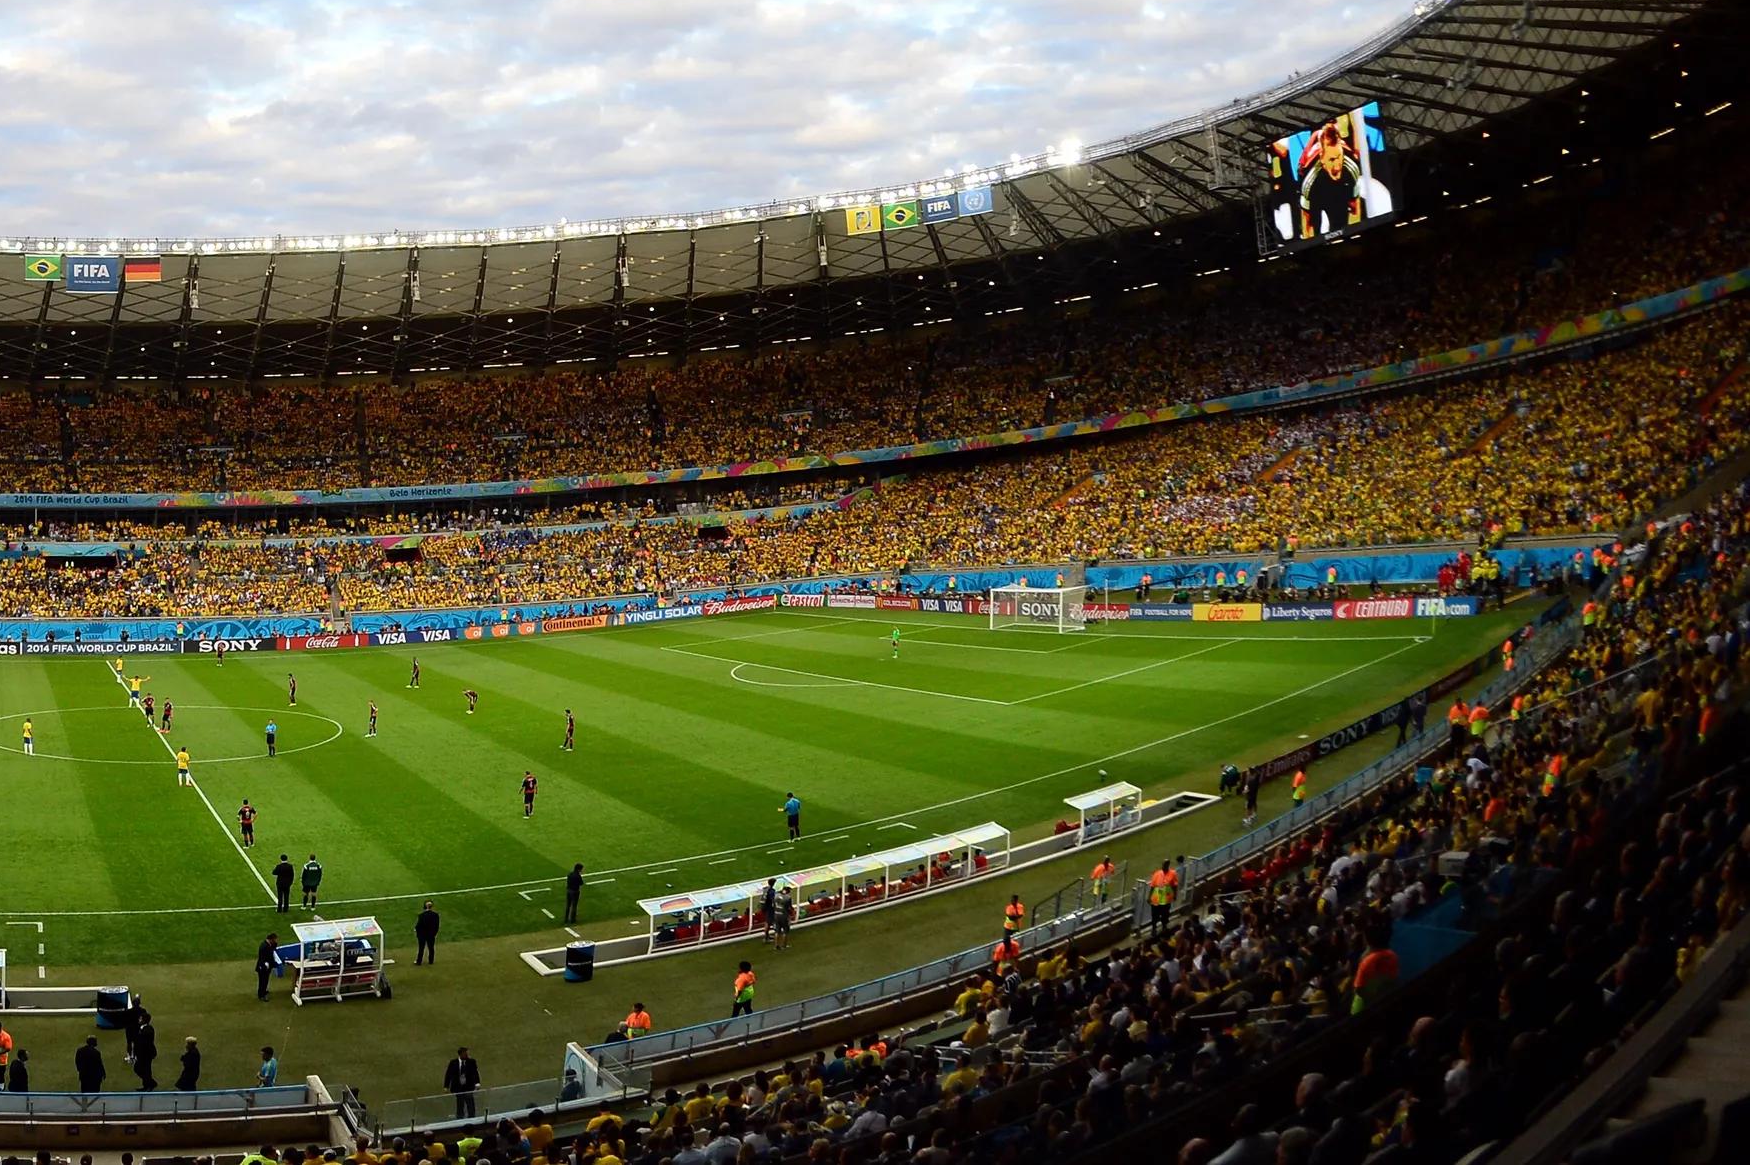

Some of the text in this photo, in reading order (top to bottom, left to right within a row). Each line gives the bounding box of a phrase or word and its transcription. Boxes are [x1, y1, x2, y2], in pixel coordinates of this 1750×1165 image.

[927, 199, 952, 214] FIFA
[73, 264, 111, 278] FIFA
[389, 487, 452, 498] Belo Horizonte
[14, 495, 128, 506] 2014 FIFA World Cup Brazil
[705, 597, 776, 615] Budweiser
[789, 595, 823, 608] Castrol
[921, 598, 940, 611] VISA
[943, 600, 963, 613] VISA
[1354, 599, 1410, 618] CENTAURO
[627, 606, 703, 624] YINGLI SOLAR
[1021, 603, 1060, 616] SONY
[1272, 607, 1333, 621] Liberty Seguros
[543, 616, 595, 631] Continental
[376, 629, 451, 645] VISA VISA
[26, 644, 50, 653] 2014
[52, 644, 75, 653] FIFA
[76, 644, 114, 653] WORLD
[115, 643, 137, 653] CUP
[198, 638, 263, 652] SONY
[1319, 721, 1373, 755] SONY
